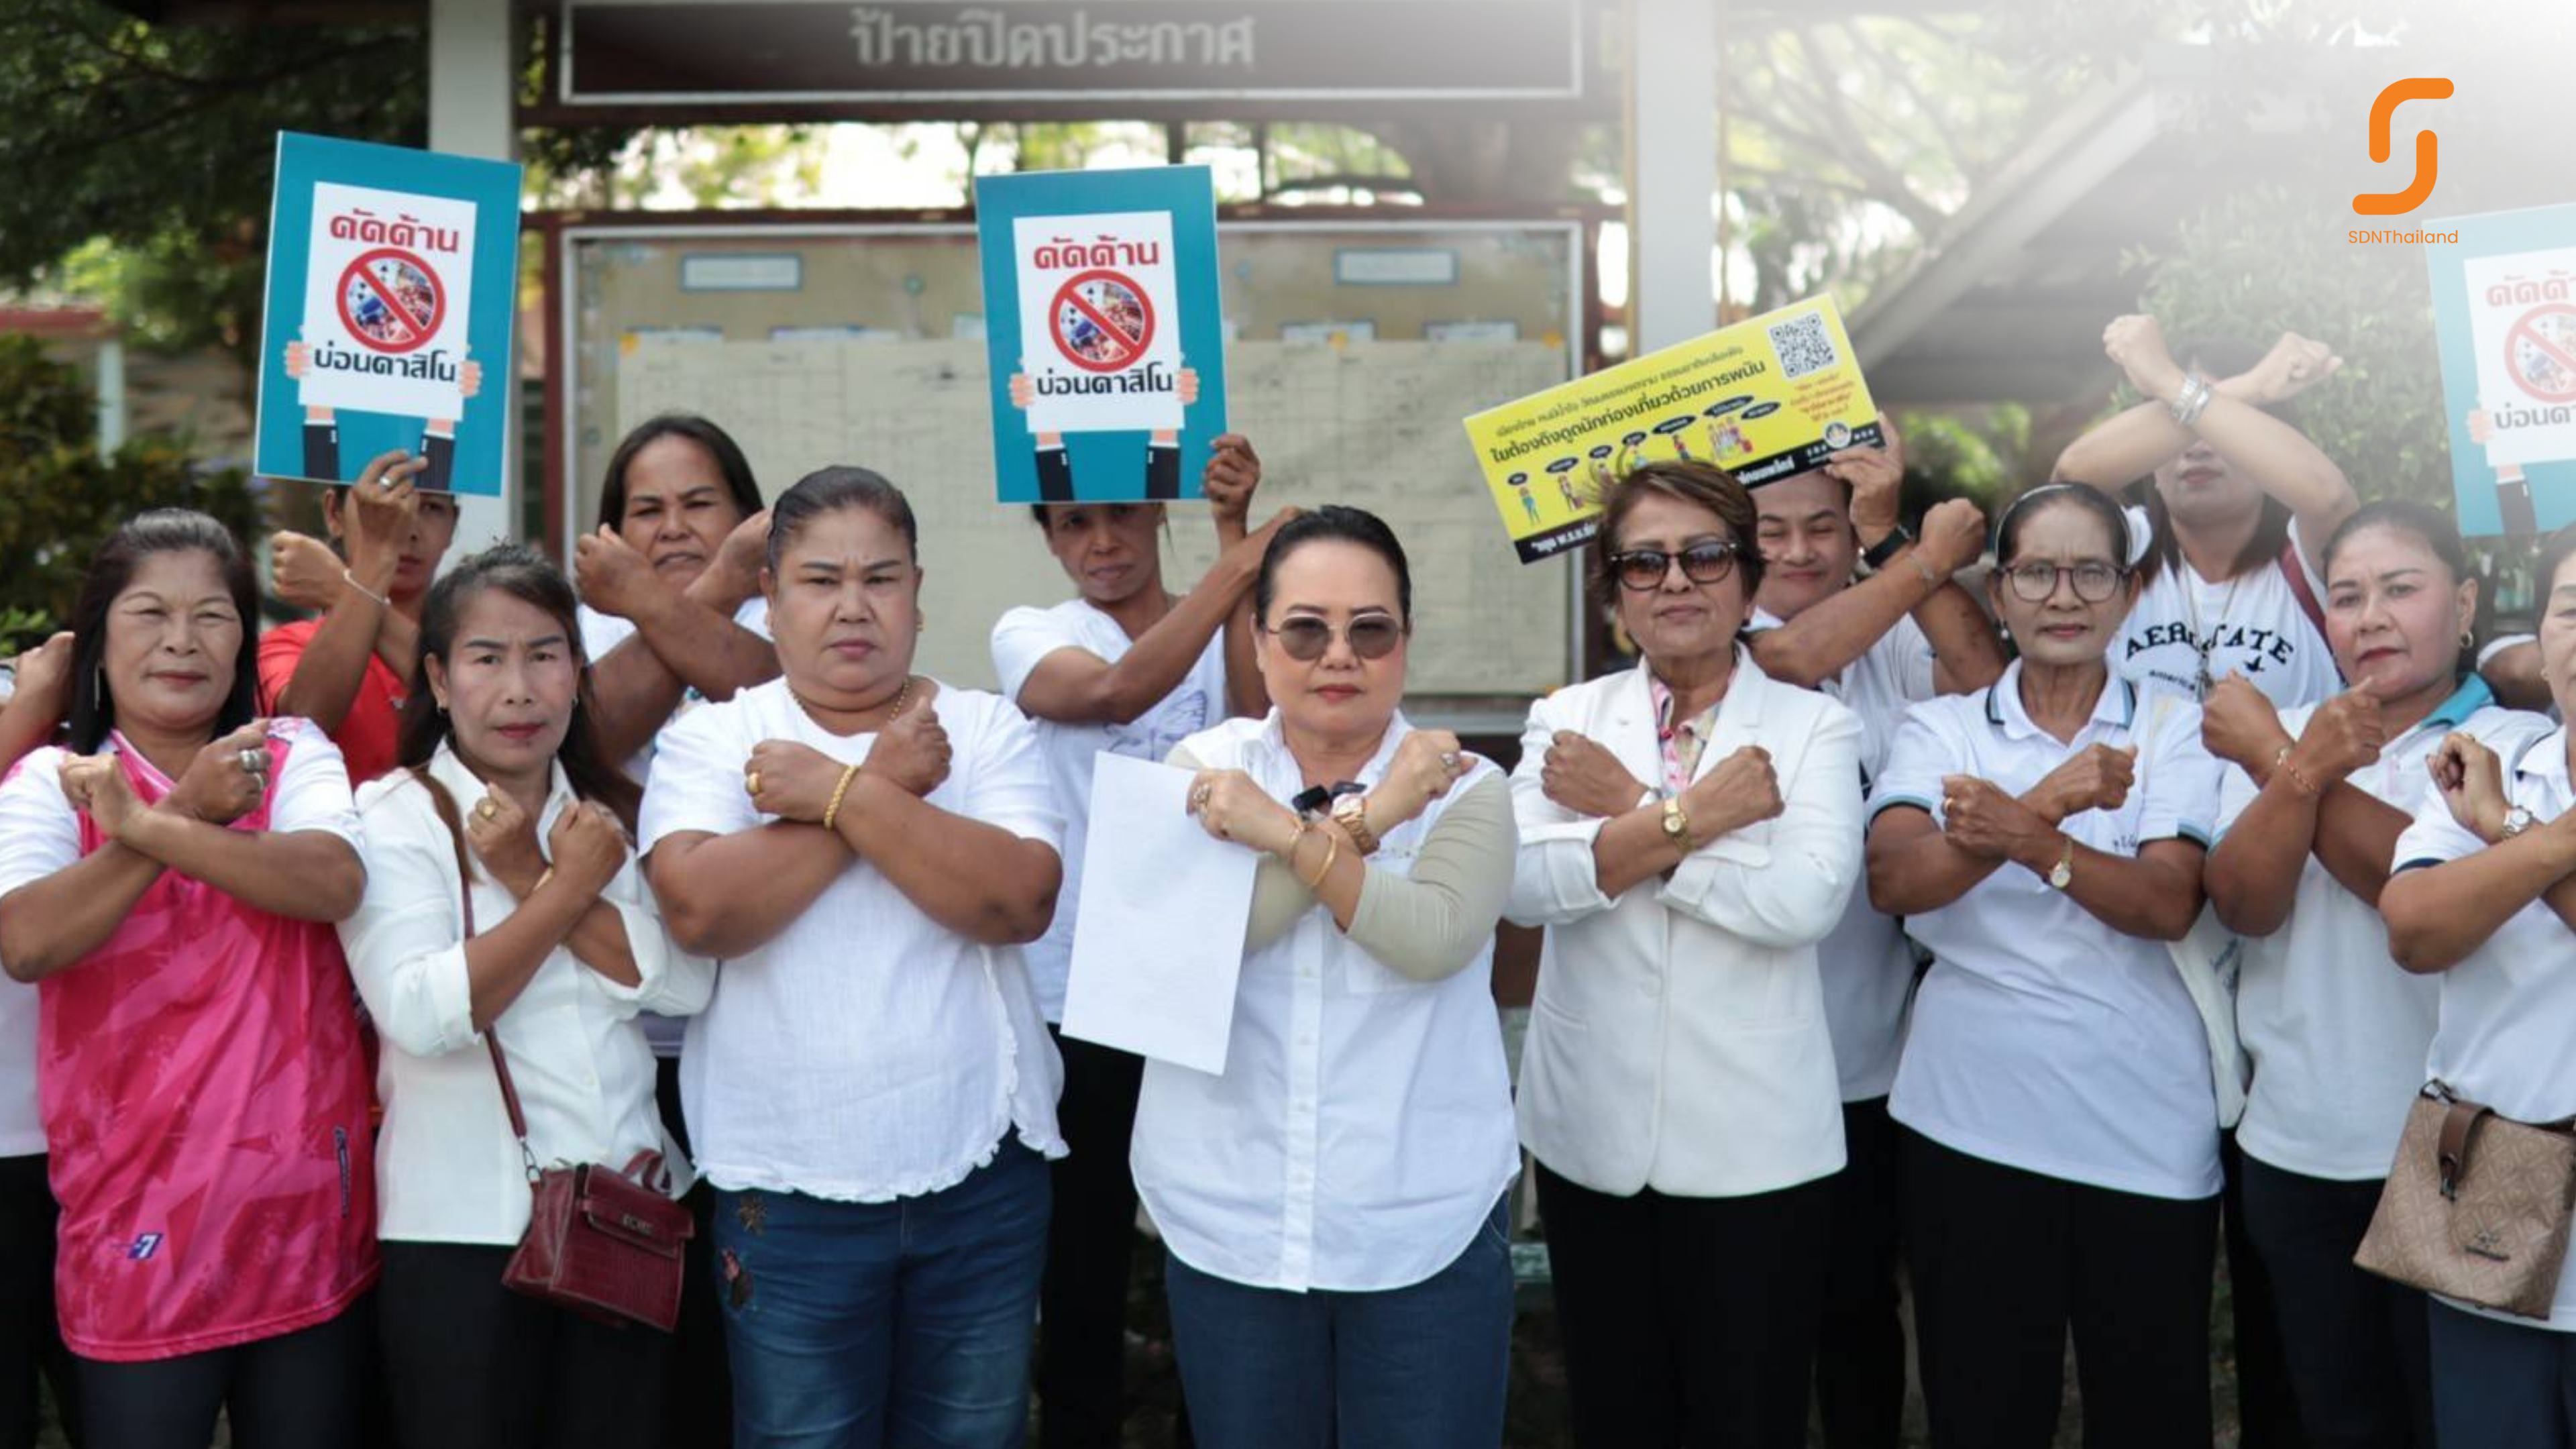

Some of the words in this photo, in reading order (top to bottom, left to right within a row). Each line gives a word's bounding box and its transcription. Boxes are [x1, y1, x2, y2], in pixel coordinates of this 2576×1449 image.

[849, 5, 1256, 71] ป้ายปิดประกาศ
[330, 208, 460, 254] คัดค้าน
[1034, 234, 1159, 269] คัดค้าน
[2485, 270, 2576, 307] คัดค้
[314, 340, 456, 382] บ่อนคาสิโน
[1036, 361, 1173, 396] บ่อนคาสิโน
[2494, 400, 2576, 429] บ่อนค
